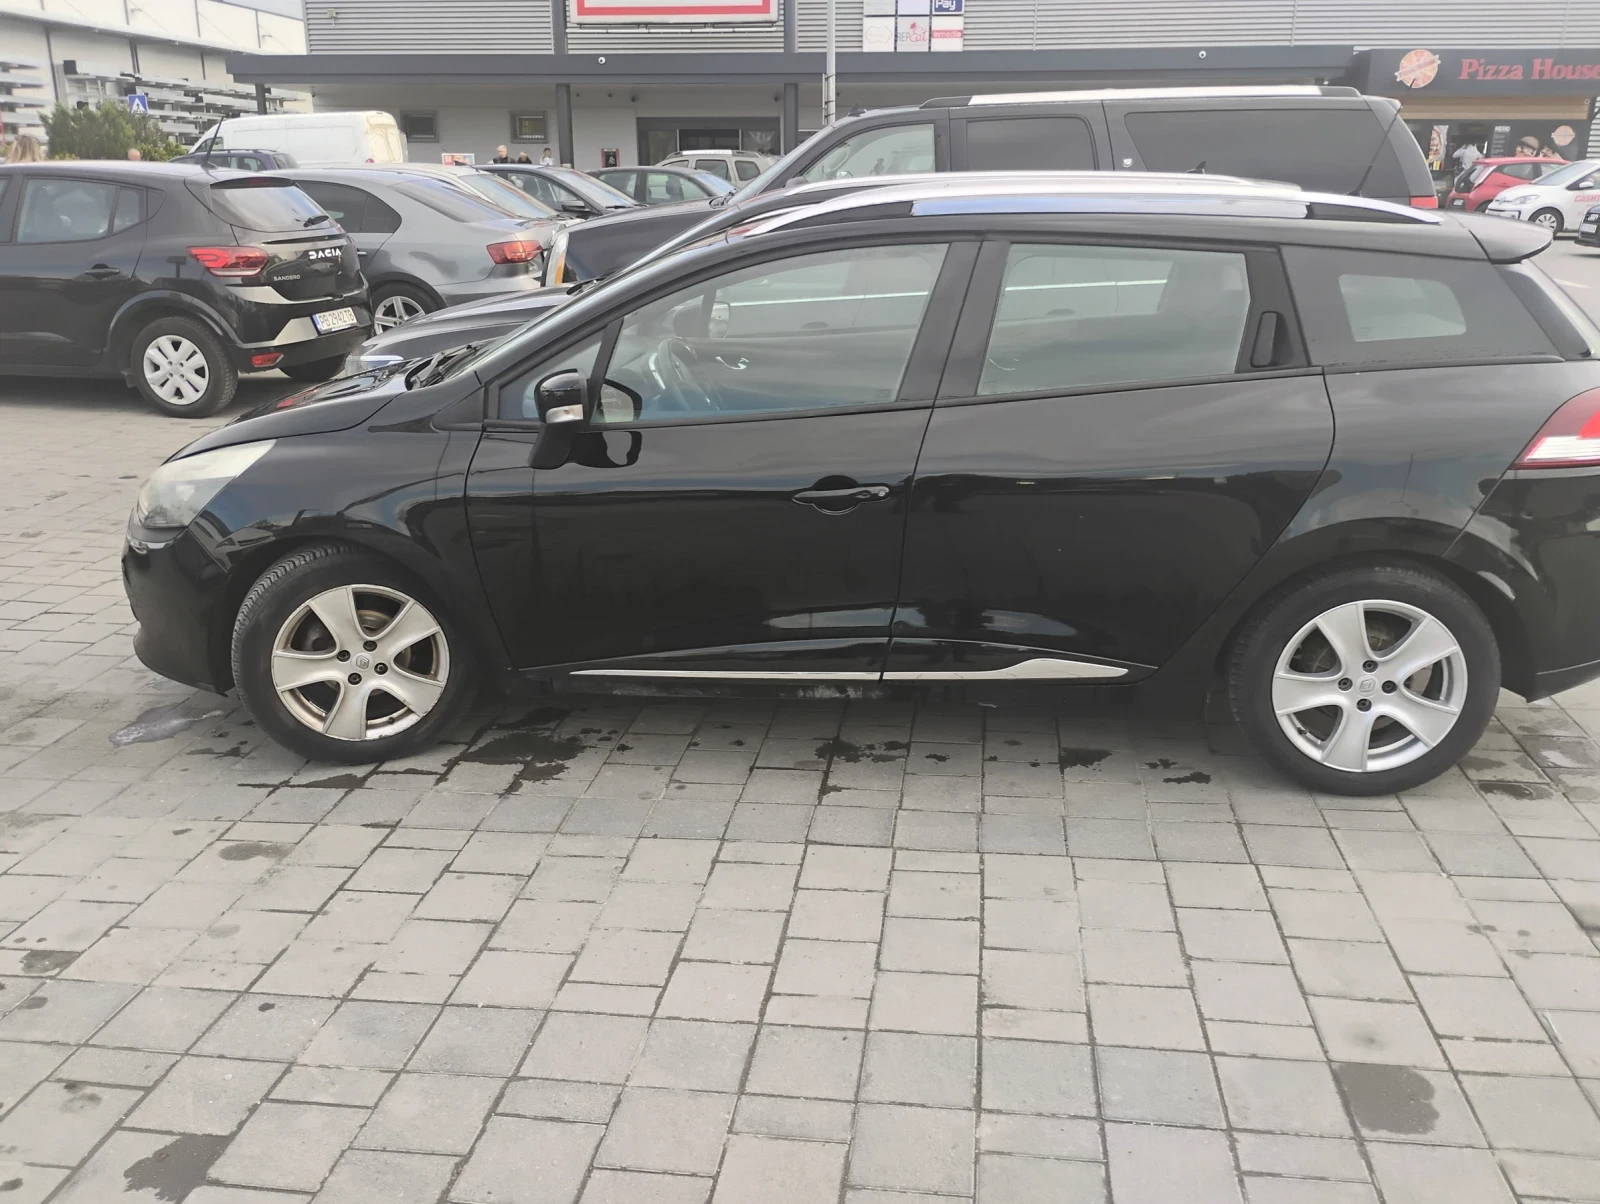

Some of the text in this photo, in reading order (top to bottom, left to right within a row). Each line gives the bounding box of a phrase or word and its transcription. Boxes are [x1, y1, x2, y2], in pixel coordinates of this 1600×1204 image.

[936, 0, 956, 11] Pay
[1458, 58, 1524, 80] Pizza
[308, 248, 342, 260] DACIA
[273, 274, 301, 282] SANDERO
